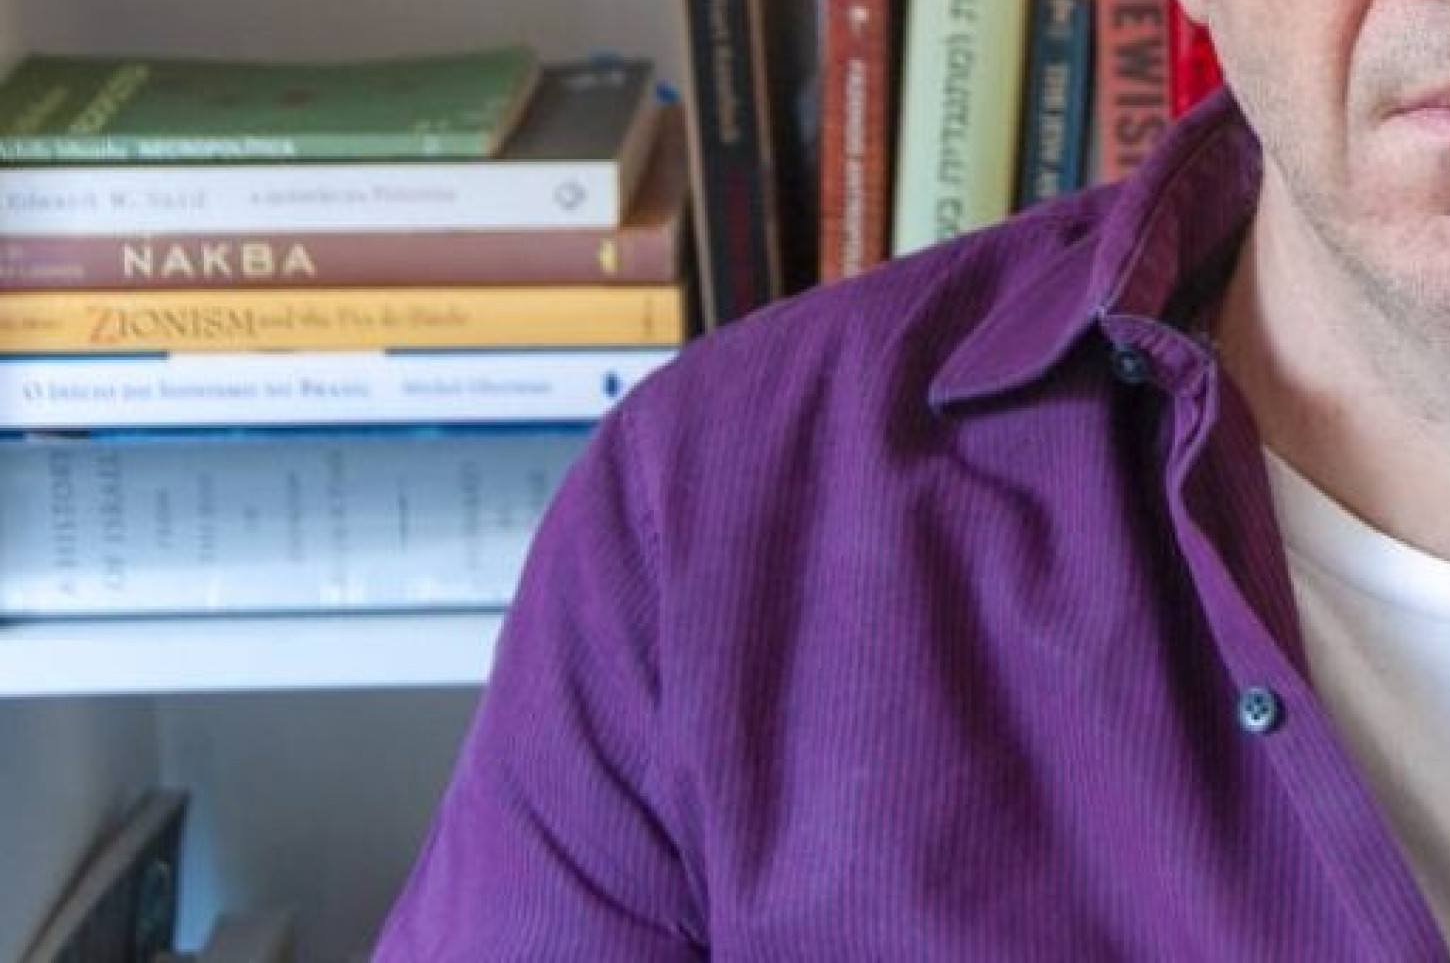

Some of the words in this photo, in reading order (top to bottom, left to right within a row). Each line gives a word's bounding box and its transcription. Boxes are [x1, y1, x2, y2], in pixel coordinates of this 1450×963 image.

[121, 241, 317, 279] NAKBA
[87, 305, 256, 343] ZIONISM
[49, 448, 76, 568] HISTORY
[94, 450, 125, 544] ISRAEL
